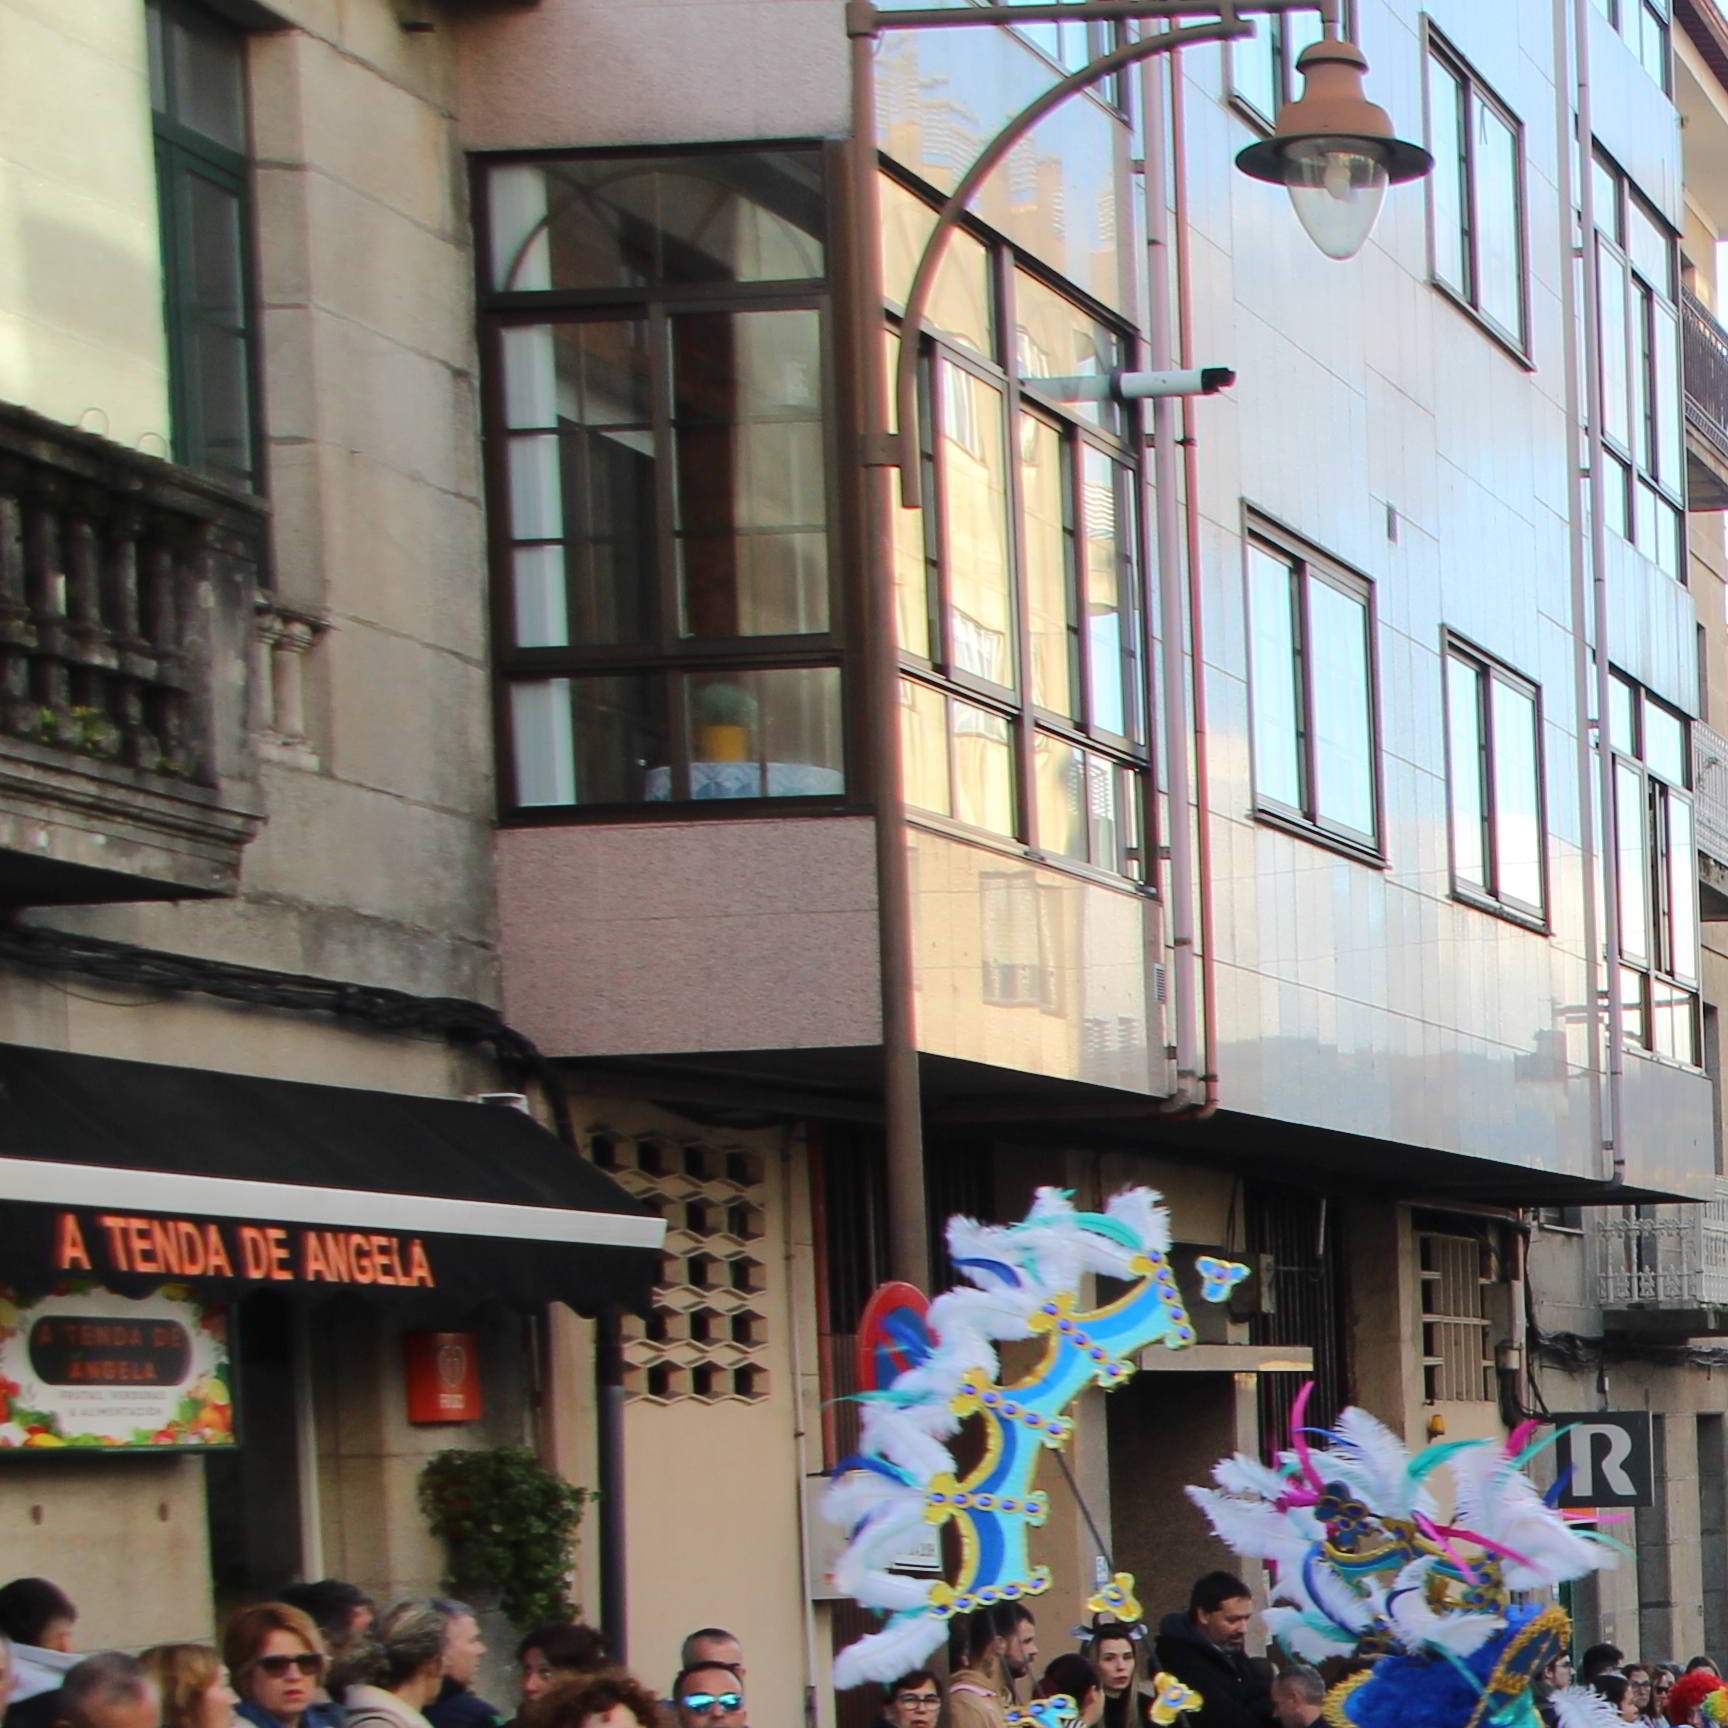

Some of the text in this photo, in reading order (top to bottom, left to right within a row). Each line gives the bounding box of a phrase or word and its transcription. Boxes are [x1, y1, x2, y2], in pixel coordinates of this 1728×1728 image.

[57, 1213, 437, 1288] A TENDA DE ANGELA
[68, 1360, 156, 1380] ANGELA
[1570, 1424, 1637, 1497] R
